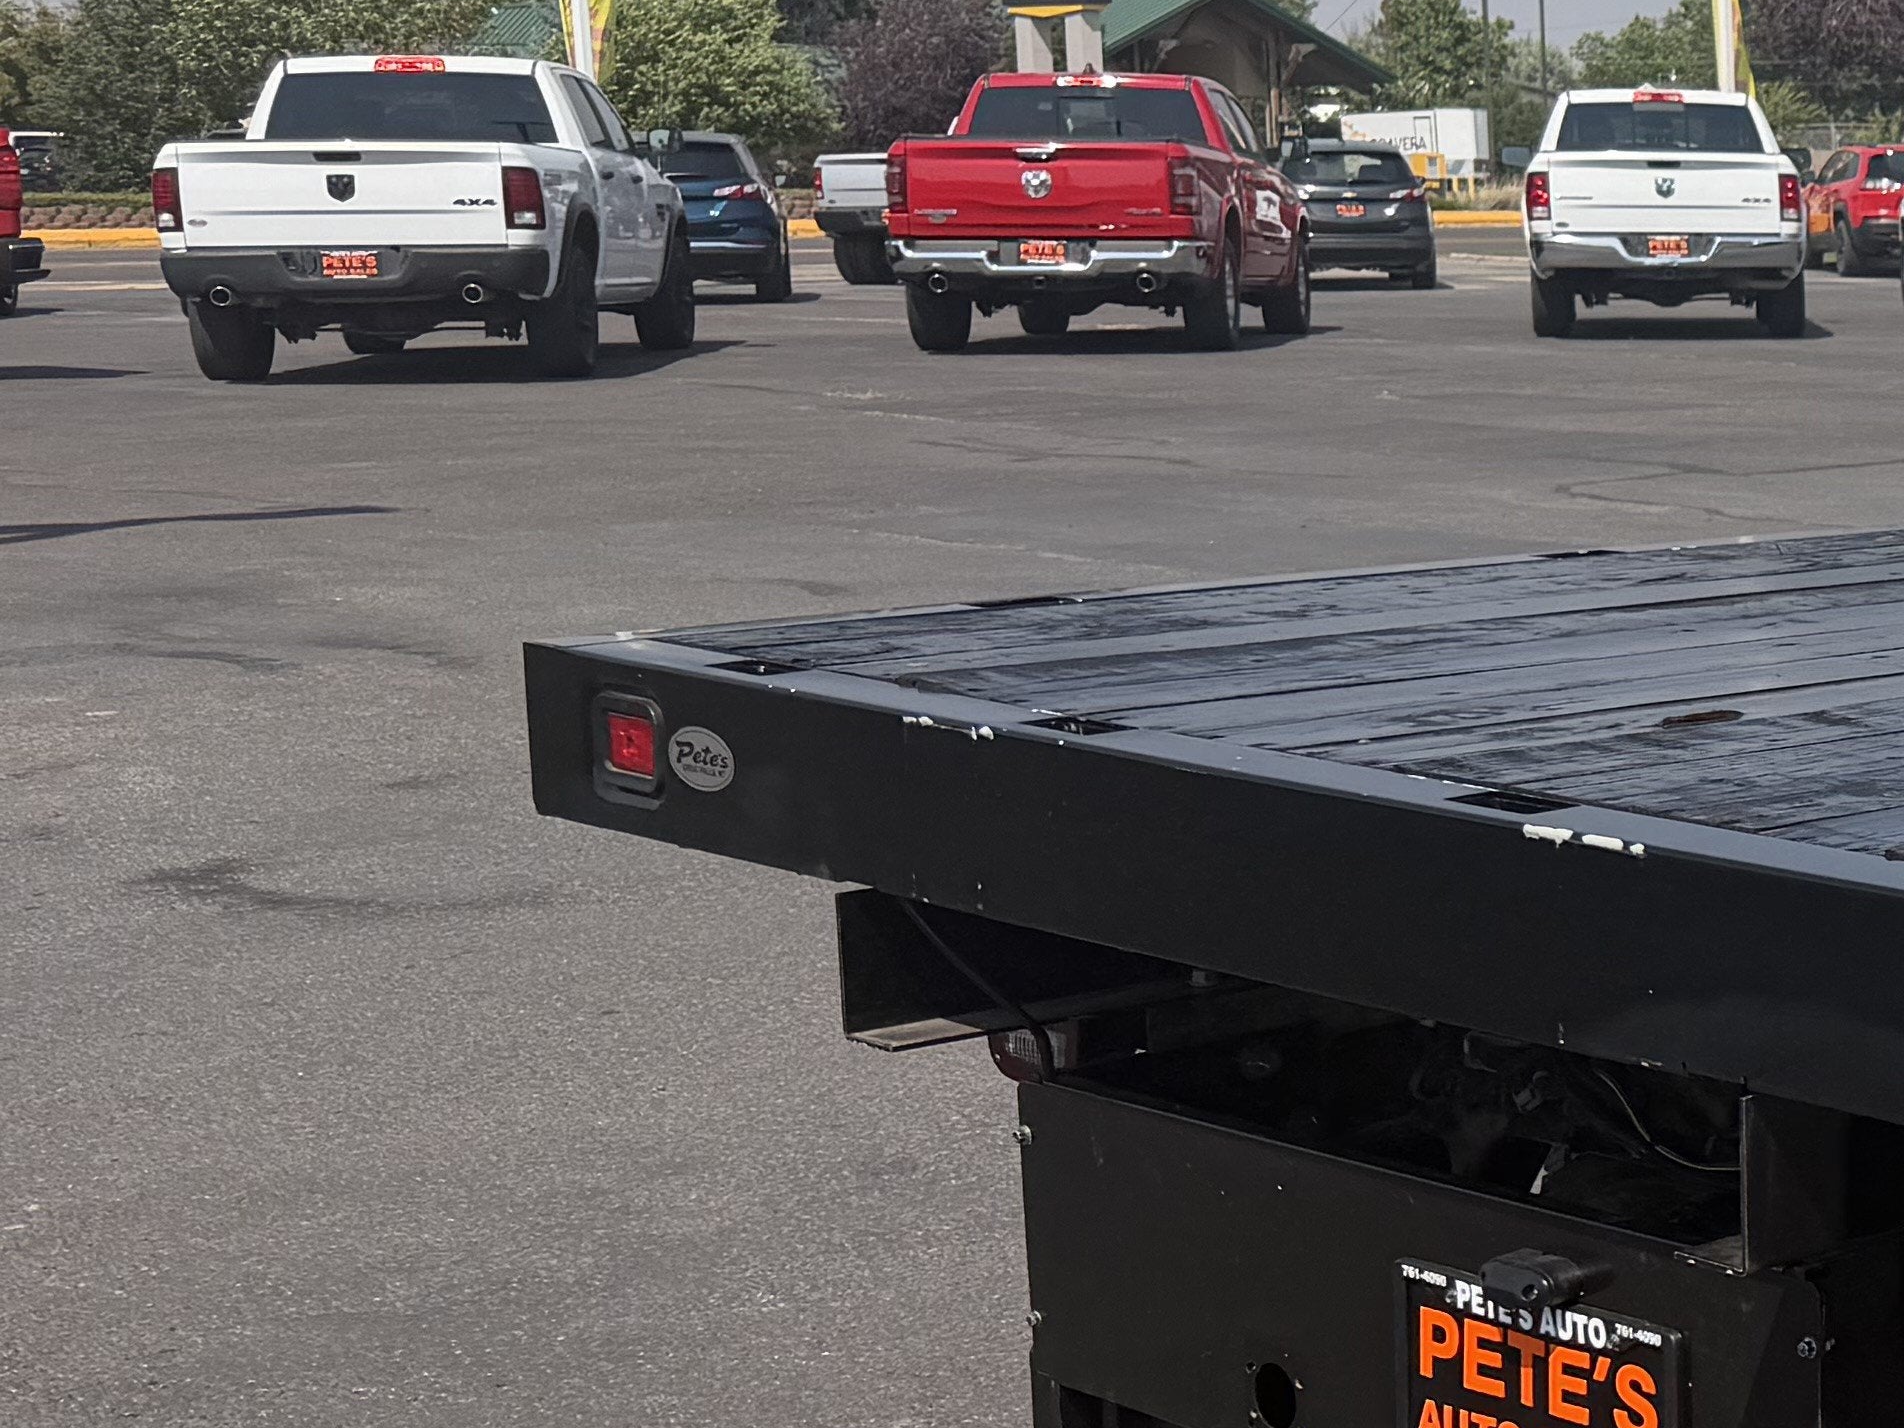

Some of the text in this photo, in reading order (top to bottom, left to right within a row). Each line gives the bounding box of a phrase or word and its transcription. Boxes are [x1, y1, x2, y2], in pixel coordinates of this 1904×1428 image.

[675, 740, 729, 769] Pete's
[1539, 1308, 1607, 1349] AUTO
[1615, 1323, 1662, 1347] 761-4090
